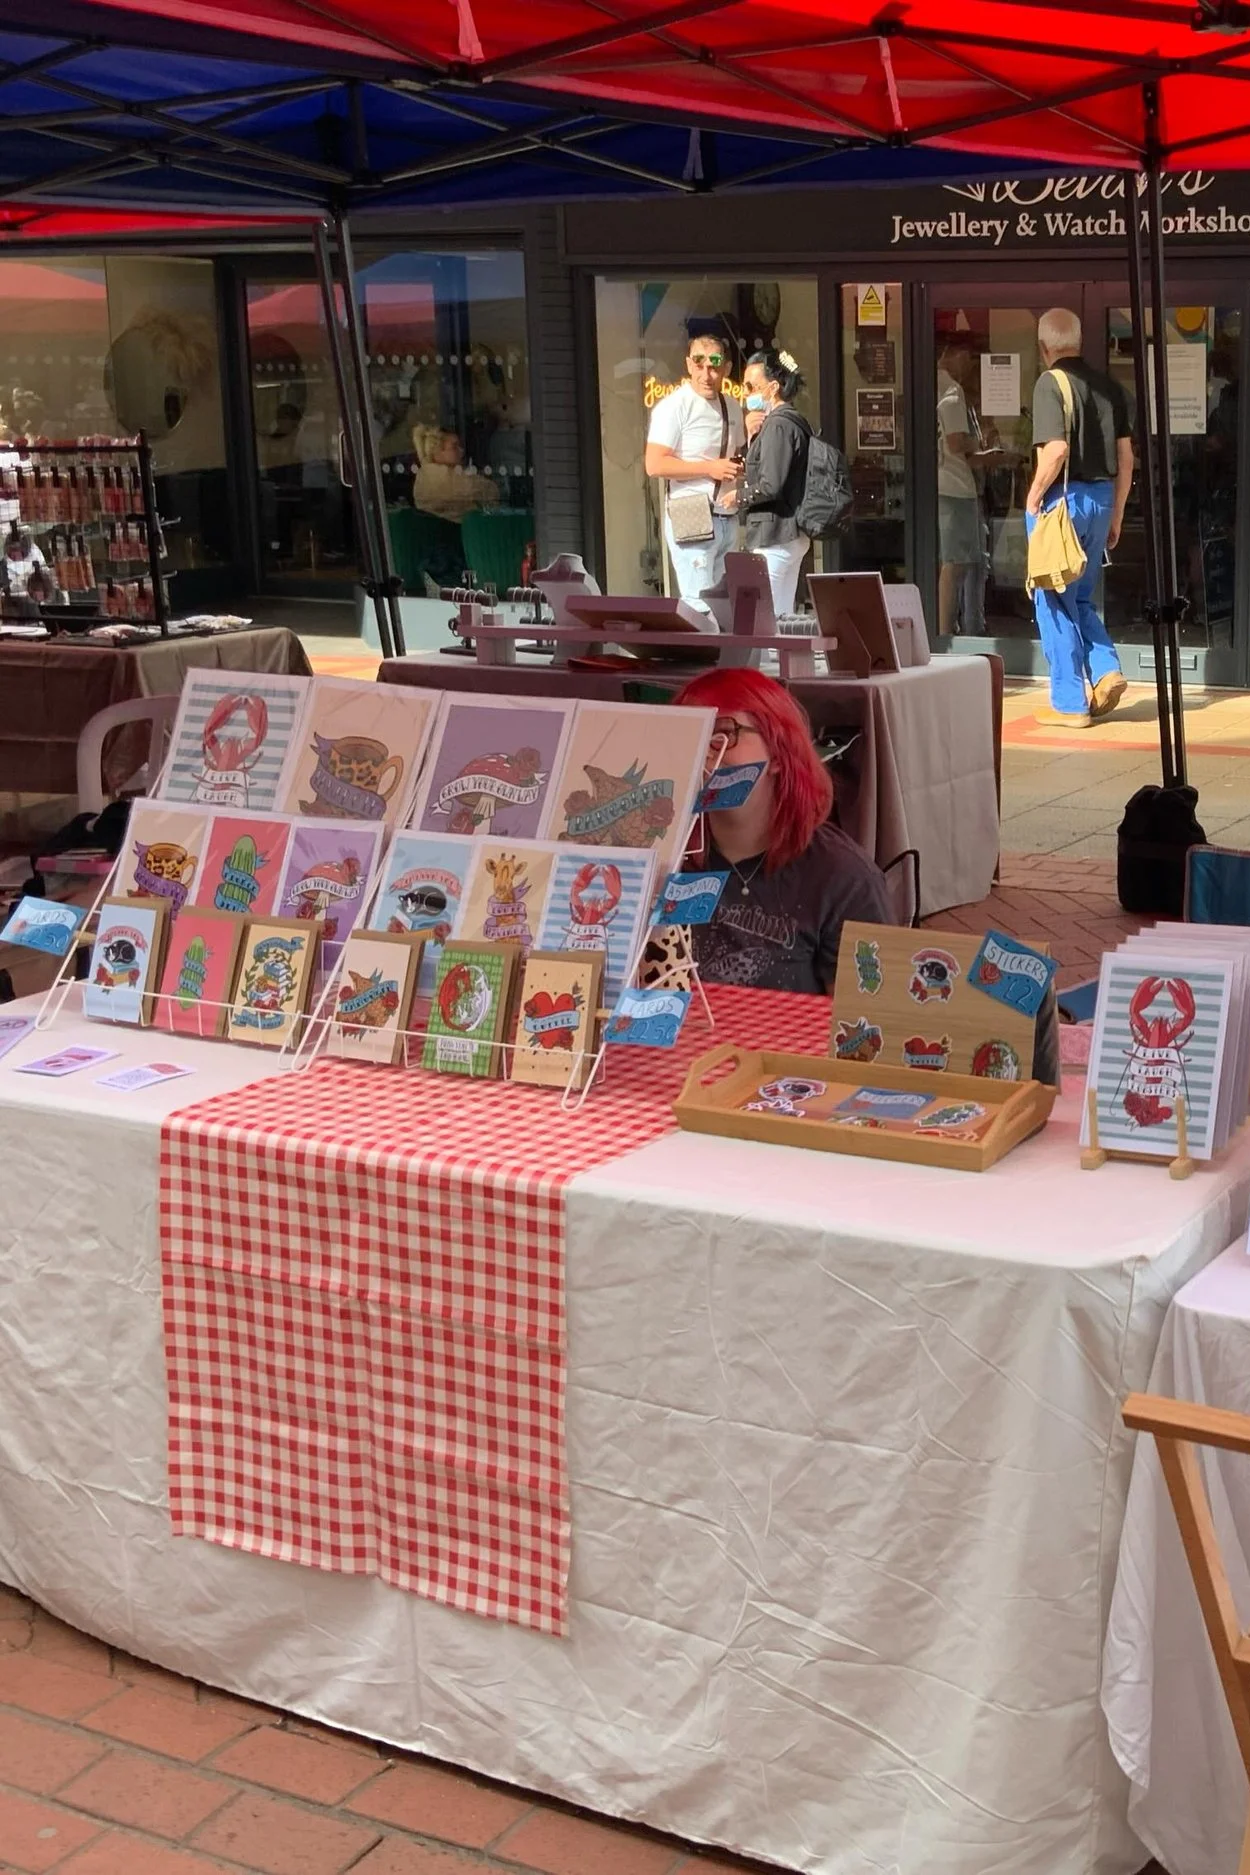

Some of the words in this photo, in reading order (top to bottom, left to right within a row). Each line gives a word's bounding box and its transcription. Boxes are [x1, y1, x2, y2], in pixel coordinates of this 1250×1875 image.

[891, 211, 1009, 245] Jewellery
[1016, 212, 1037, 237] &
[1044, 210, 1127, 237] Watch
[987, 946, 1045, 982] STICKERS
